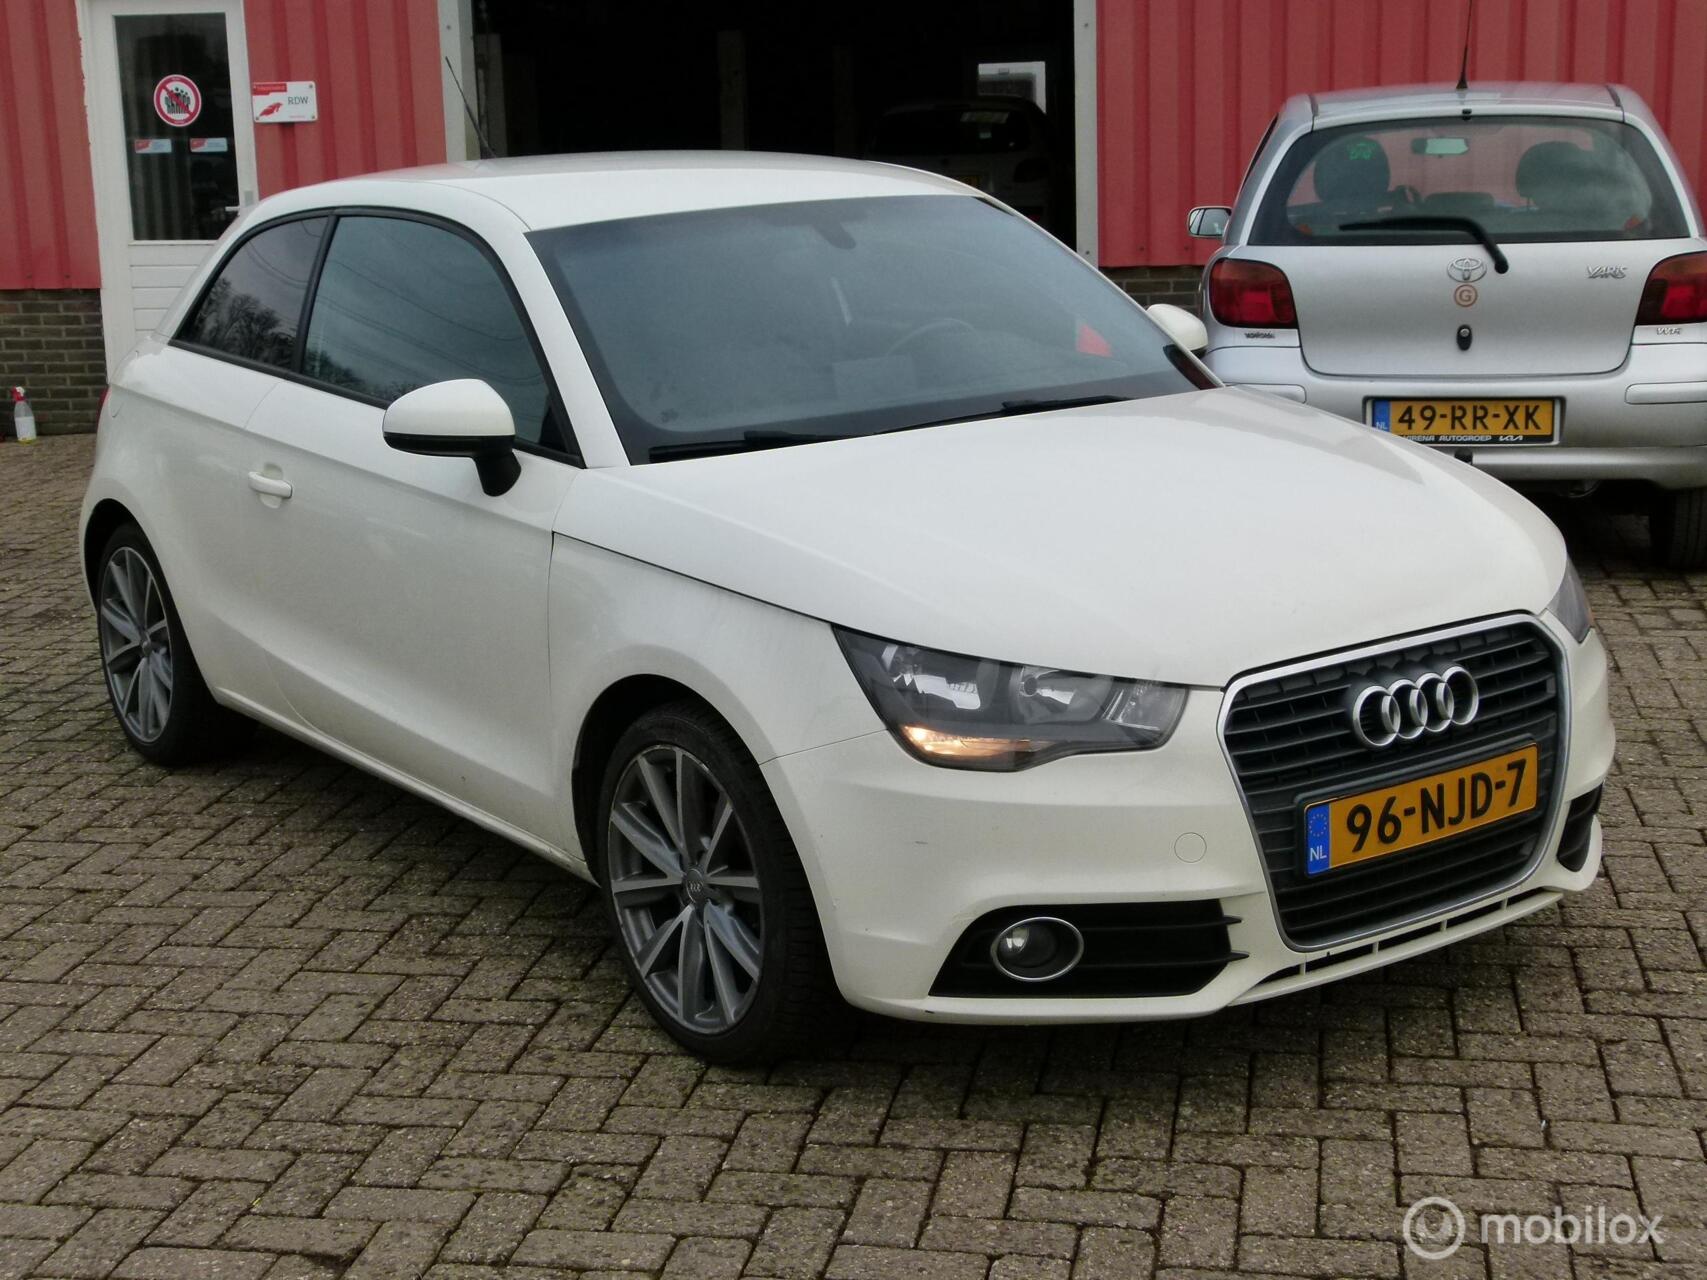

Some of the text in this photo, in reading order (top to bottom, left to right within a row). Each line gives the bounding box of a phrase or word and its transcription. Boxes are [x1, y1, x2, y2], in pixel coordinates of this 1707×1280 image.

[287, 96, 309, 105] RDW
[1375, 421, 1389, 430] NL
[1398, 405, 1541, 431] 49-RR-XK
[1347, 758, 1527, 853] 96-NJD-7
[1309, 845, 1328, 863] NL
